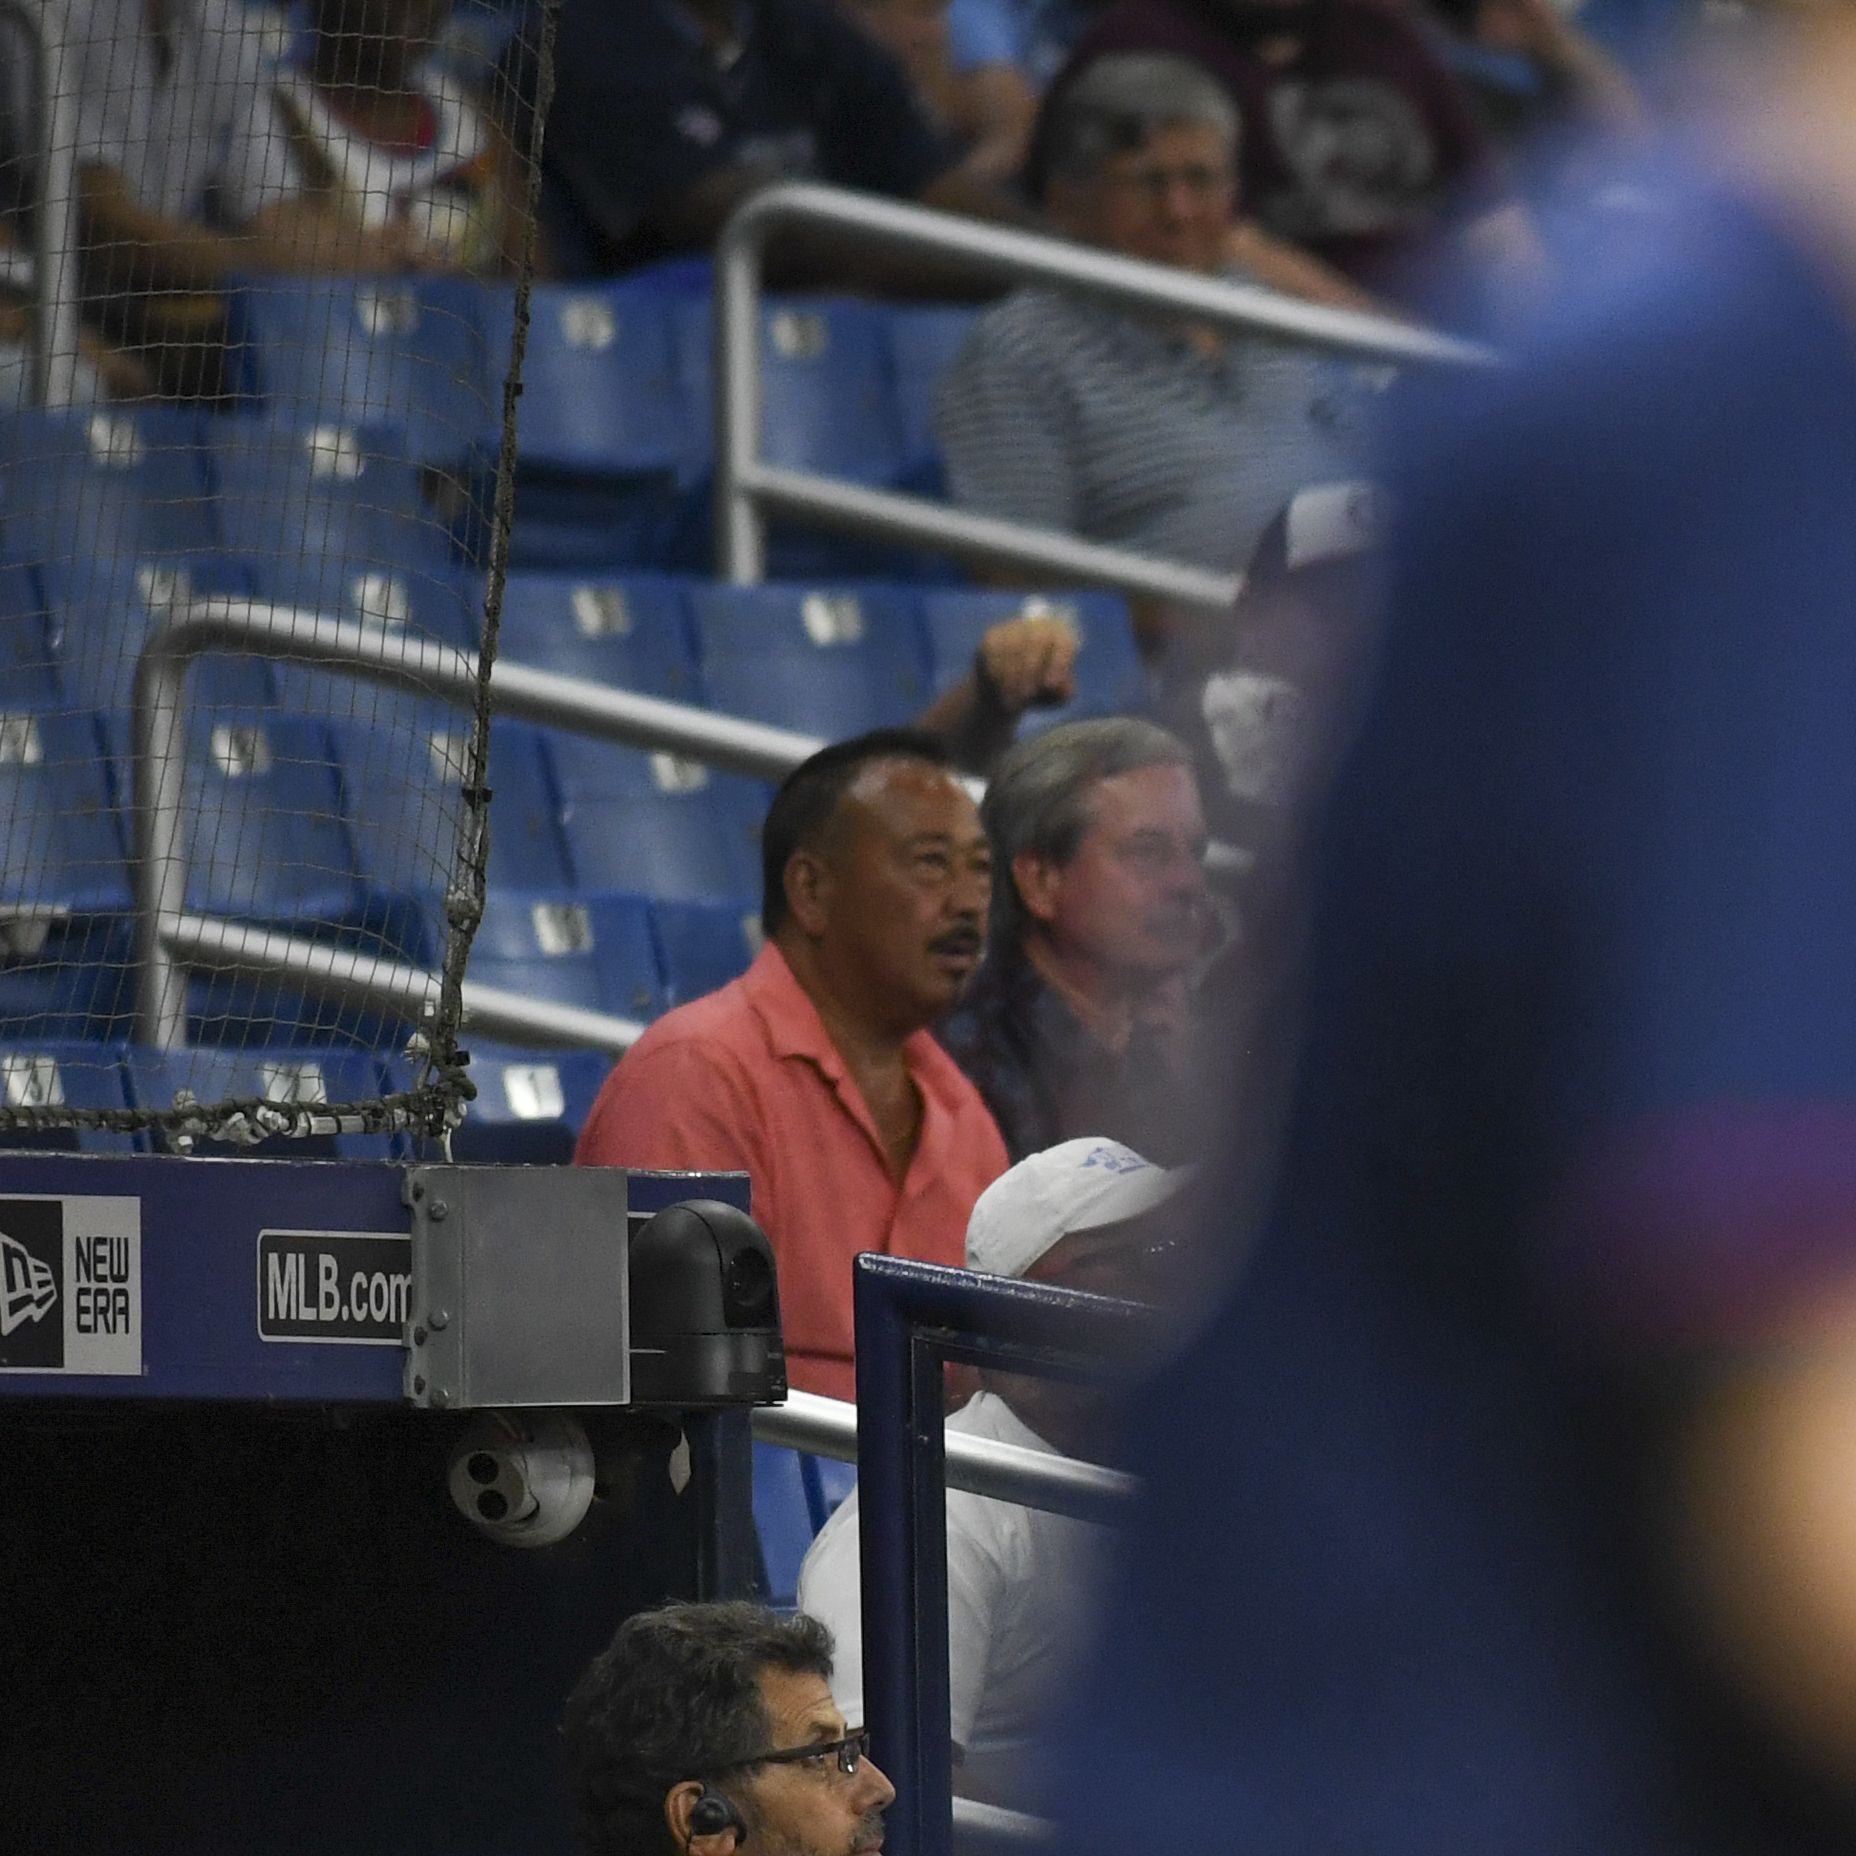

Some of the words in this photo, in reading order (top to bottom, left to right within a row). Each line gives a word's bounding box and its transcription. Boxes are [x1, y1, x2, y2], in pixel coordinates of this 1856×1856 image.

[76, 1237, 129, 1283] NEW
[76, 1287, 129, 1334] ERA
[268, 1253, 412, 1323] MLB.com
